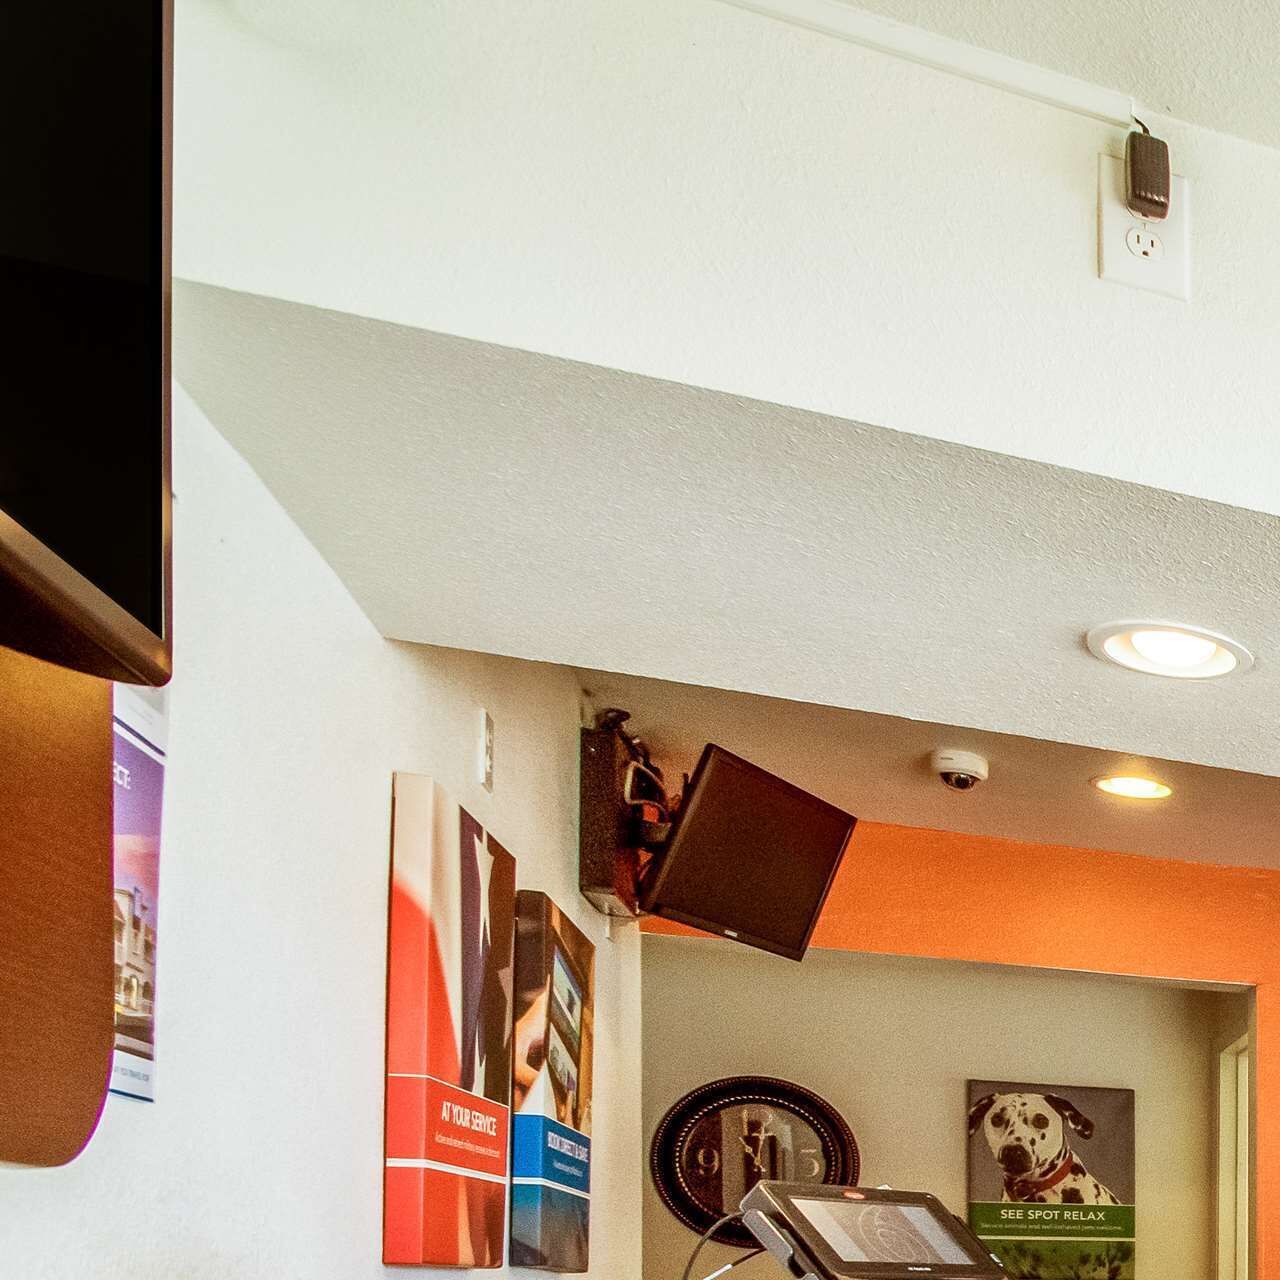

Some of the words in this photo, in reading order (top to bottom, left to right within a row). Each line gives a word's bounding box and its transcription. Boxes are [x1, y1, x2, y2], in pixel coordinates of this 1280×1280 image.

[442, 1101, 451, 1122] AT
[452, 1105, 471, 1129] YOUR
[471, 1111, 497, 1136] SERVICE
[1000, 1209, 1024, 1219] SEE
[1027, 1210, 1060, 1220] SPOT
[1063, 1211, 1105, 1221] RELAX
